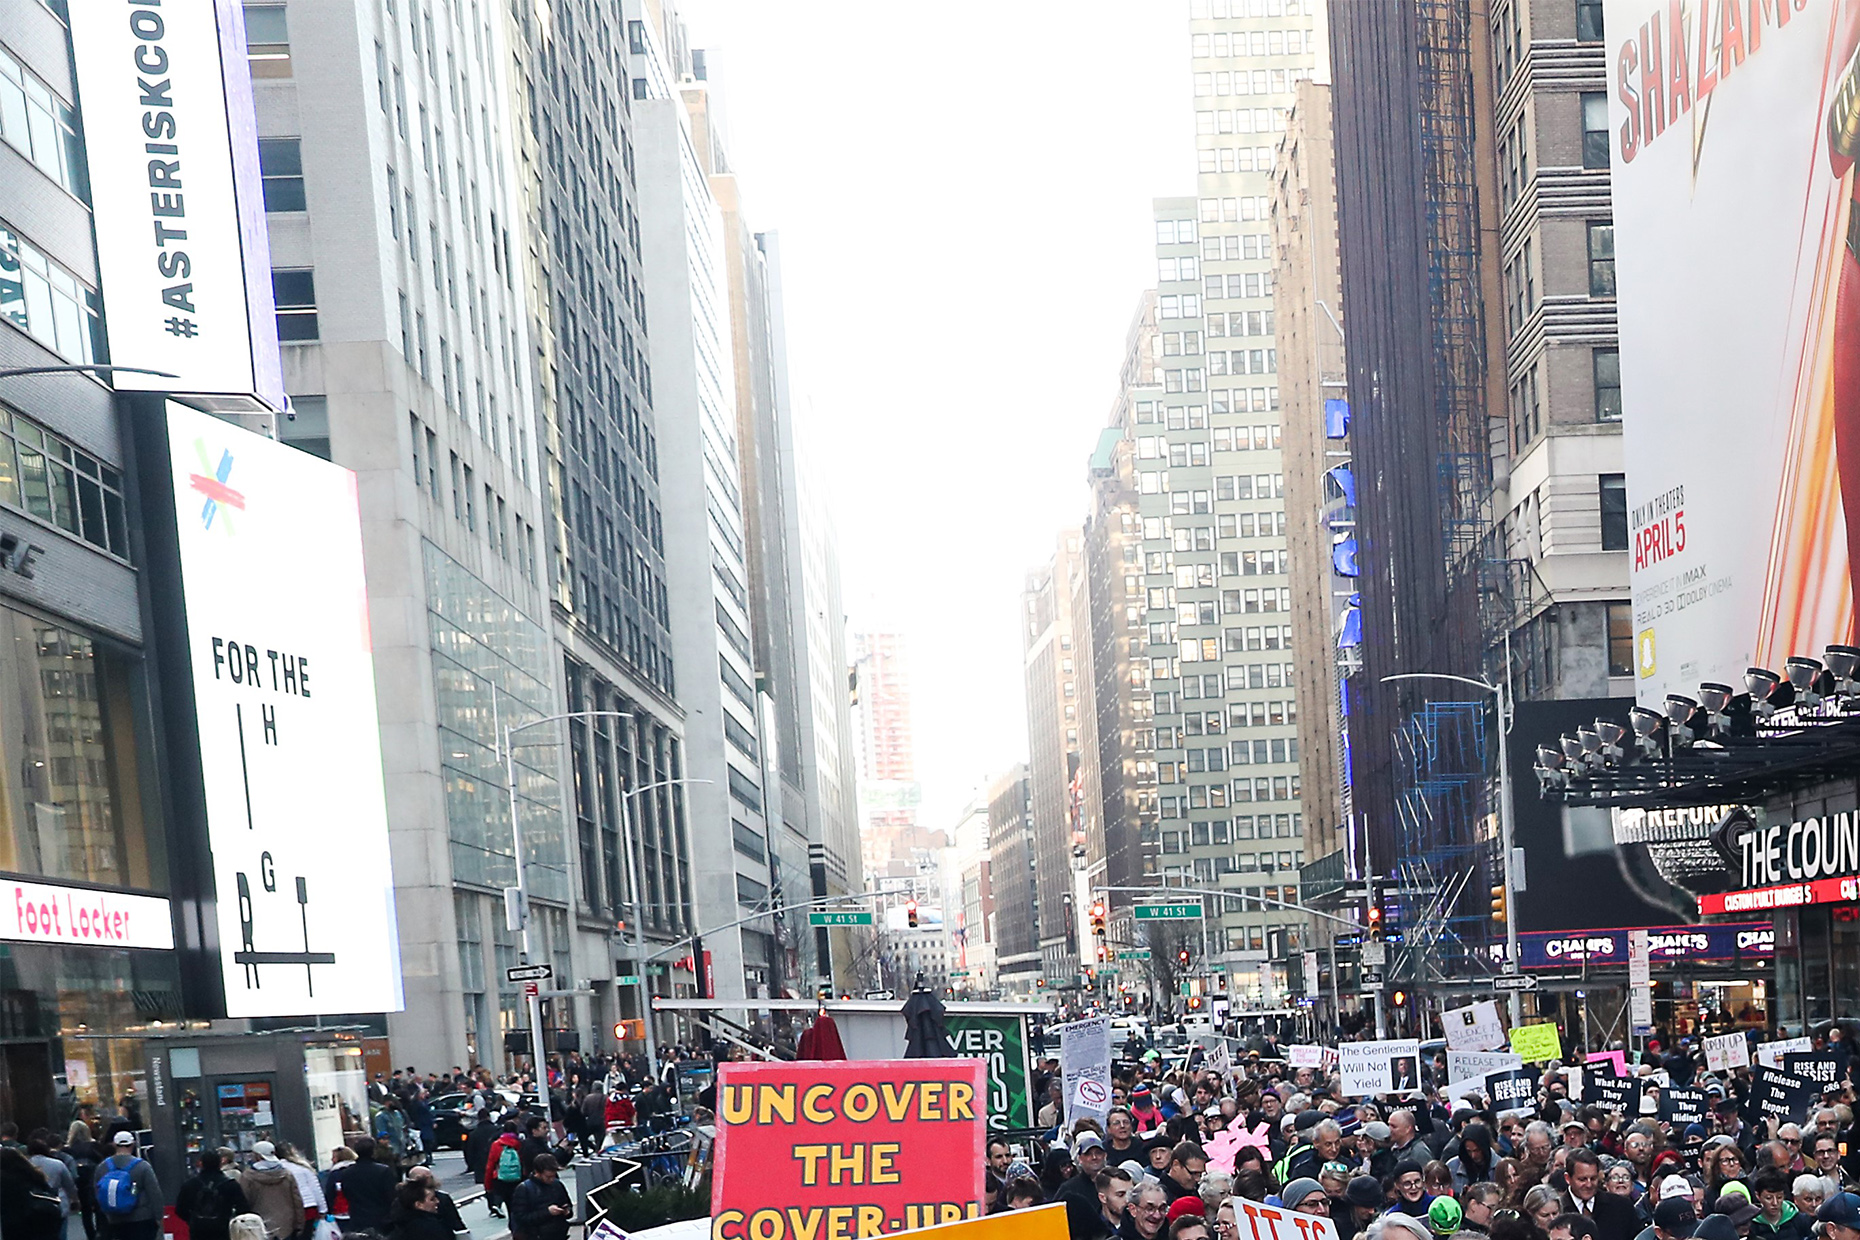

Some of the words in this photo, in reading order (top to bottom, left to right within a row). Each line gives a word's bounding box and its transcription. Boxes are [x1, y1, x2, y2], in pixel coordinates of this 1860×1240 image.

[128, 0, 199, 340] #ASTERISKCO
[1632, 504, 1646, 530] ONLY
[1647, 501, 1654, 521] IN
[1655, 485, 1684, 519] THEATERS
[1635, 518, 1674, 573] APRIL
[1676, 511, 1686, 552] 5
[211, 636, 261, 689] FOR
[267, 649, 311, 698] THE
[1739, 818, 1781, 887] THE
[15, 888, 62, 936] Foot
[67, 893, 129, 941] Locker
[1150, 908, 1158, 916] W
[1163, 908, 1173, 916] 41
[1177, 907, 1186, 916] St
[1705, 1038, 1726, 1051] OPEN
[1729, 1034, 1743, 1047] UP
[1341, 1047, 1361, 1056] The
[1364, 1044, 1418, 1055] Gentleman
[1343, 1062, 1365, 1073] Will
[1367, 1061, 1387, 1071] Not
[1455, 1056, 1494, 1067] RELEASE
[1794, 1062, 1815, 1072] RISE
[1817, 1061, 1836, 1071] AND
[1353, 1078, 1382, 1089] Yield
[1494, 1080, 1513, 1091] RISE
[1516, 1078, 1531, 1088] AND
[1595, 1078, 1614, 1089] What
[1616, 1080, 1632, 1089] Are
[1762, 1070, 1801, 1089] #Release
[1495, 1087, 1532, 1100] RESIST
[1602, 1089, 1622, 1101] They
[1770, 1087, 1786, 1099] The
[723, 1080, 975, 1126] UNCOVER
[1678, 1101, 1697, 1112] They
[1761, 1100, 1790, 1115] Report
[1672, 1112, 1703, 1123] Hiding?
[794, 1142, 901, 1186] THE
